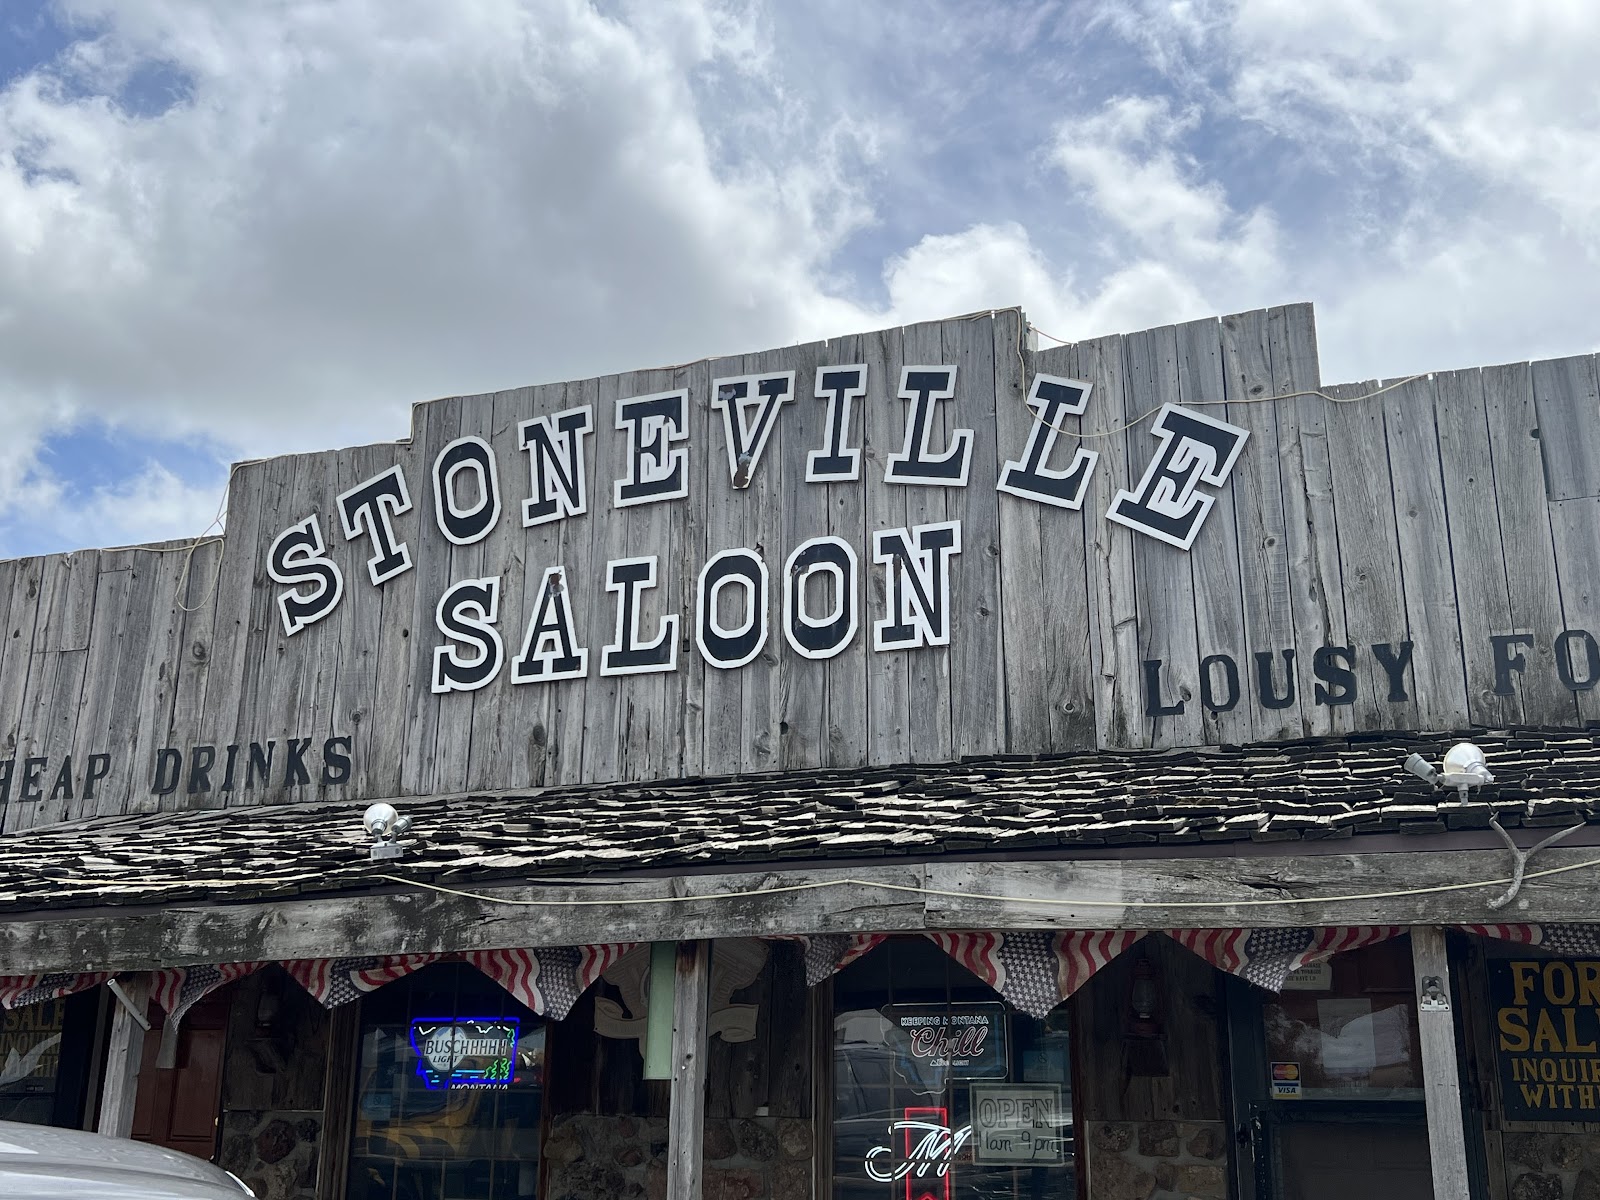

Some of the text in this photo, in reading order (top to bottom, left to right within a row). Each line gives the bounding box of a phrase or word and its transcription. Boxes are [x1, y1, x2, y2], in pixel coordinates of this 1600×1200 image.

[267, 363, 1250, 635] STONEVILLE
[431, 520, 962, 693] SALOON
[1143, 640, 1413, 717] LOUSY
[151, 736, 352, 796] DRINKS
[1510, 961, 1600, 1006] FOR
[900, 1016, 940, 1026] KEEPING
[910, 1026, 988, 1058] Chill
[1498, 1007, 1600, 1053] SAL
[979, 1098, 1053, 1129] OPEN
[1519, 1084, 1600, 1110] WITH
